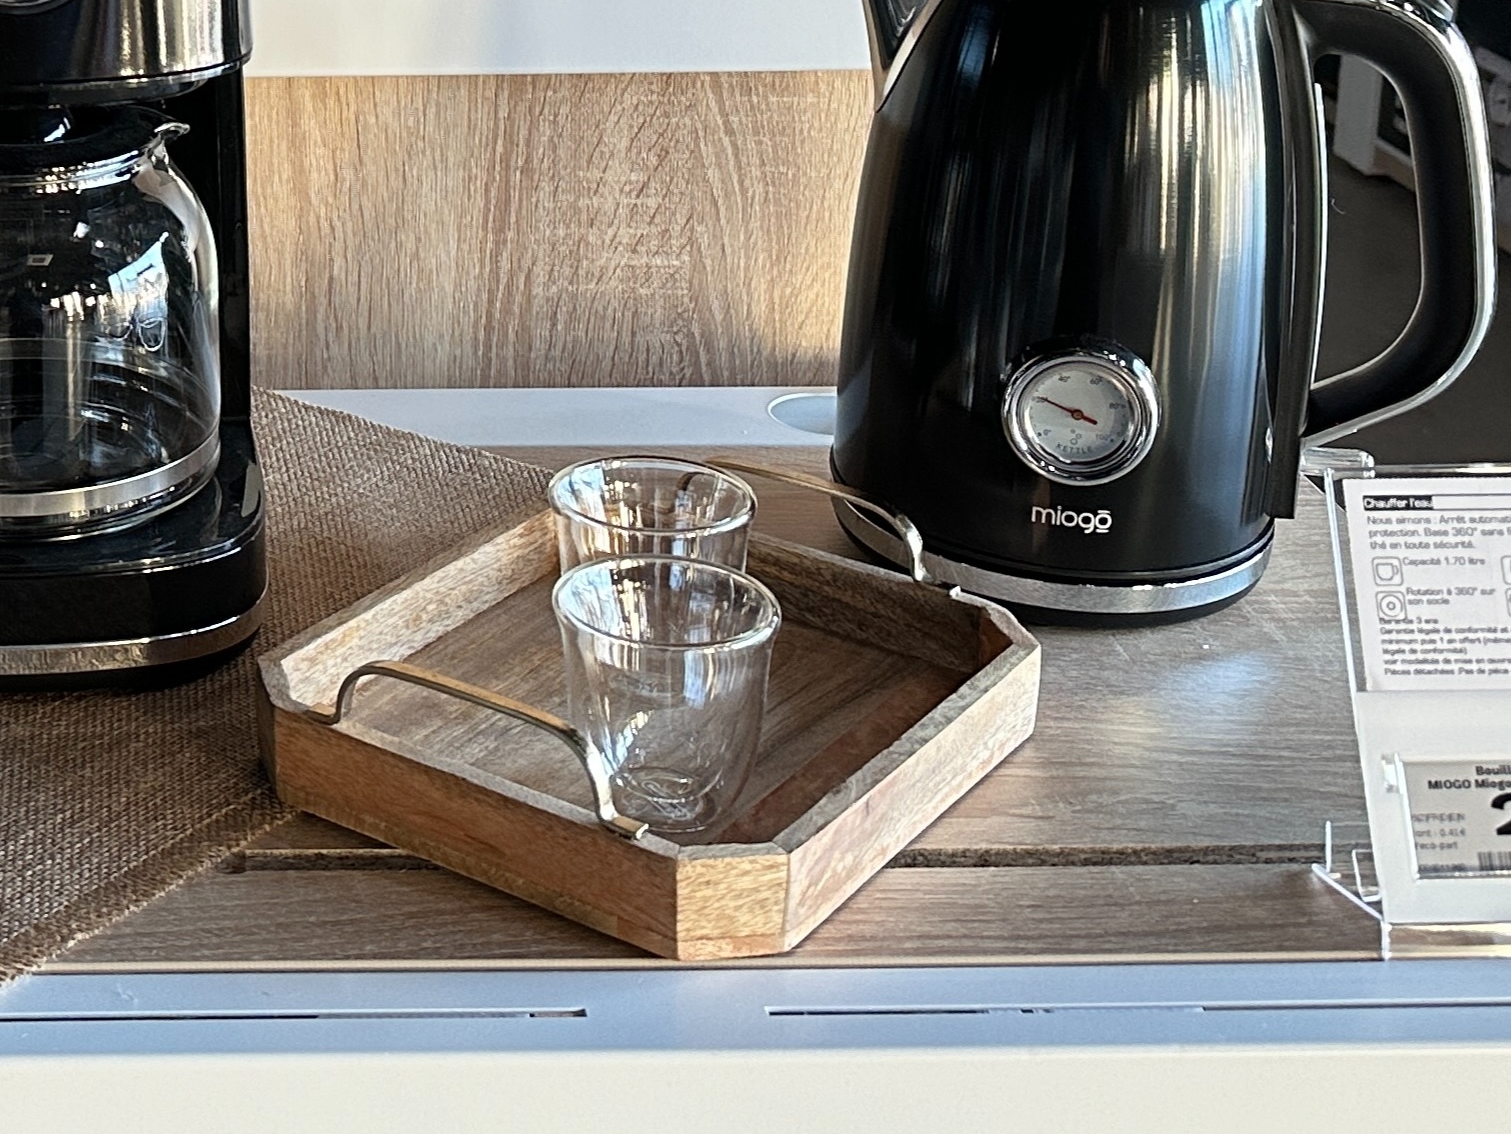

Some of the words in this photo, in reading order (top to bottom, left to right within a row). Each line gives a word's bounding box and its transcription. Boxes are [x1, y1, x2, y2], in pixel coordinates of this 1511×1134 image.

[1056, 443, 1095, 455] KETTLE
[1367, 515, 1393, 525] Nous
[1428, 779, 1471, 789] MIOGO
